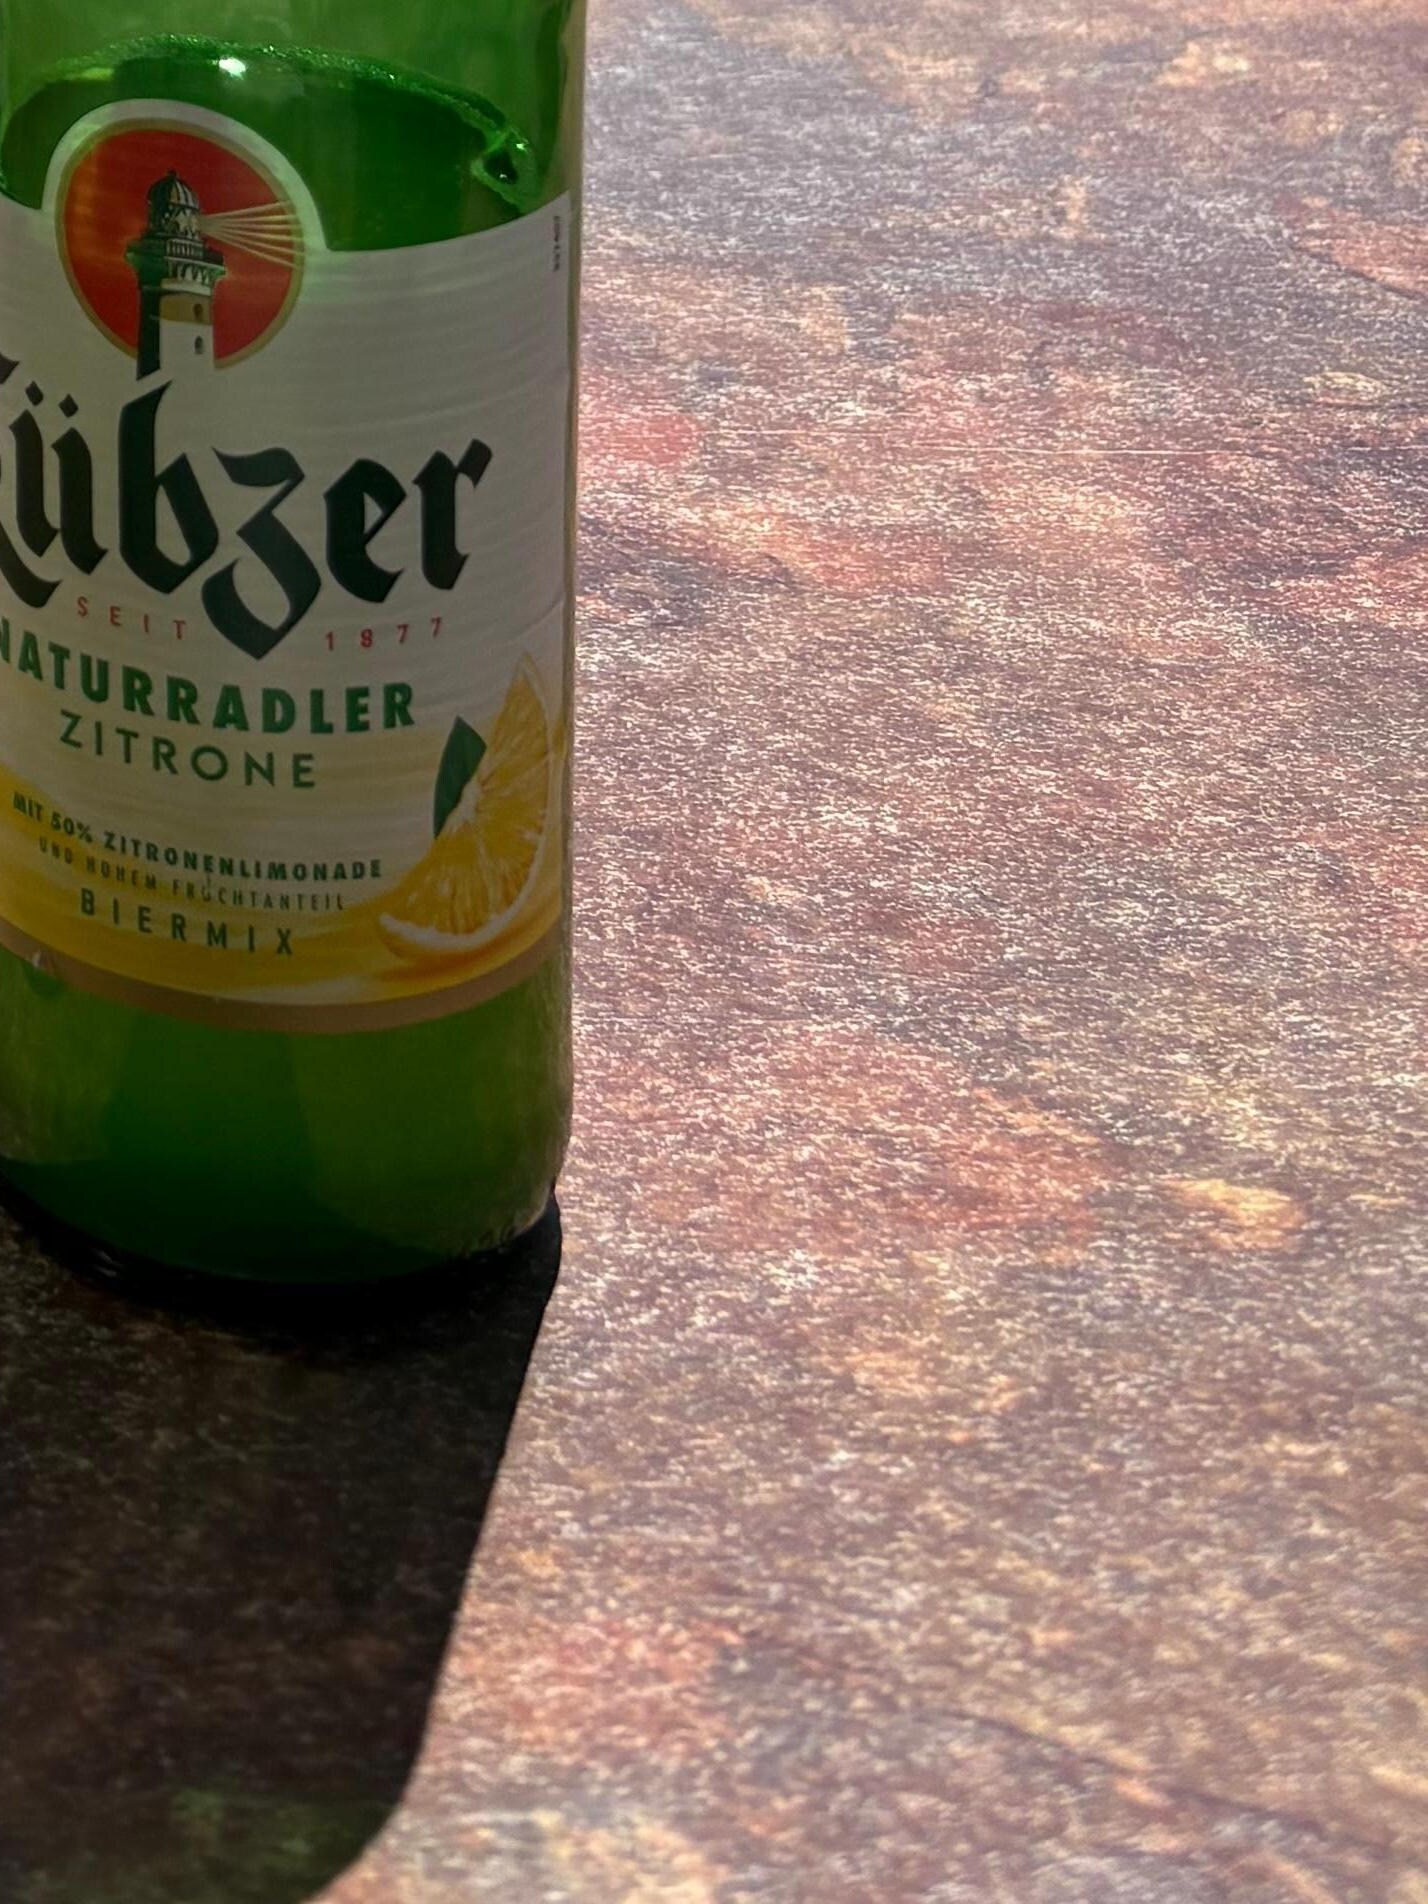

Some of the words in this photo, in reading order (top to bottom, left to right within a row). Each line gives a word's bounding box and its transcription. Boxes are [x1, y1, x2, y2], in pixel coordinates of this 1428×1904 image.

[76, 596, 187, 641] SEIT
[324, 616, 443, 652] 1877
[59, 708, 317, 789] ZITRONE
[12, 790, 44, 822] MIT
[49, 811, 94, 844] 50%
[103, 831, 383, 882] ZITRONENLIMONADE
[38, 836, 73, 865] UND
[85, 856, 158, 891] HOHEM
[79, 887, 294, 956] BIERMIX
